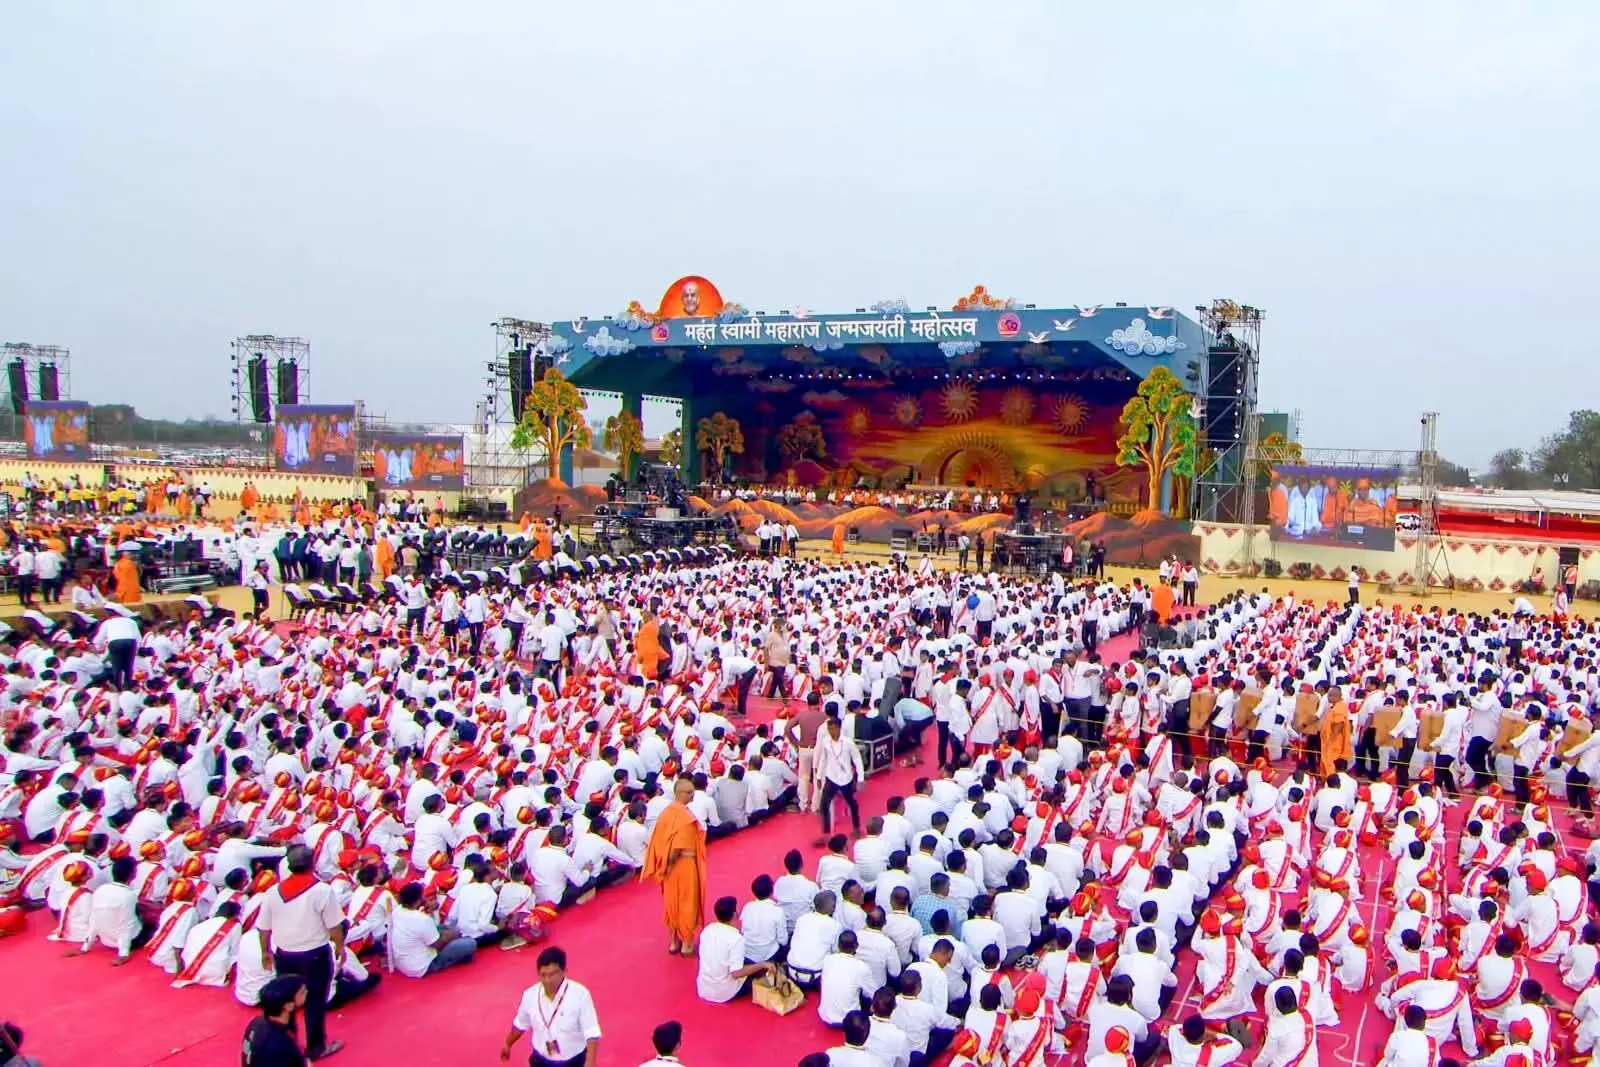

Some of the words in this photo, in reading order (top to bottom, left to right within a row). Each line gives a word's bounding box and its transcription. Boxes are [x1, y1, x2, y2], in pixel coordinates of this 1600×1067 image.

[720, 317, 762, 340] स्वामी
[765, 321, 821, 342] महाराज
[825, 314, 906, 338] जन्मजयंती
[910, 312, 978, 340] महोत्सव
